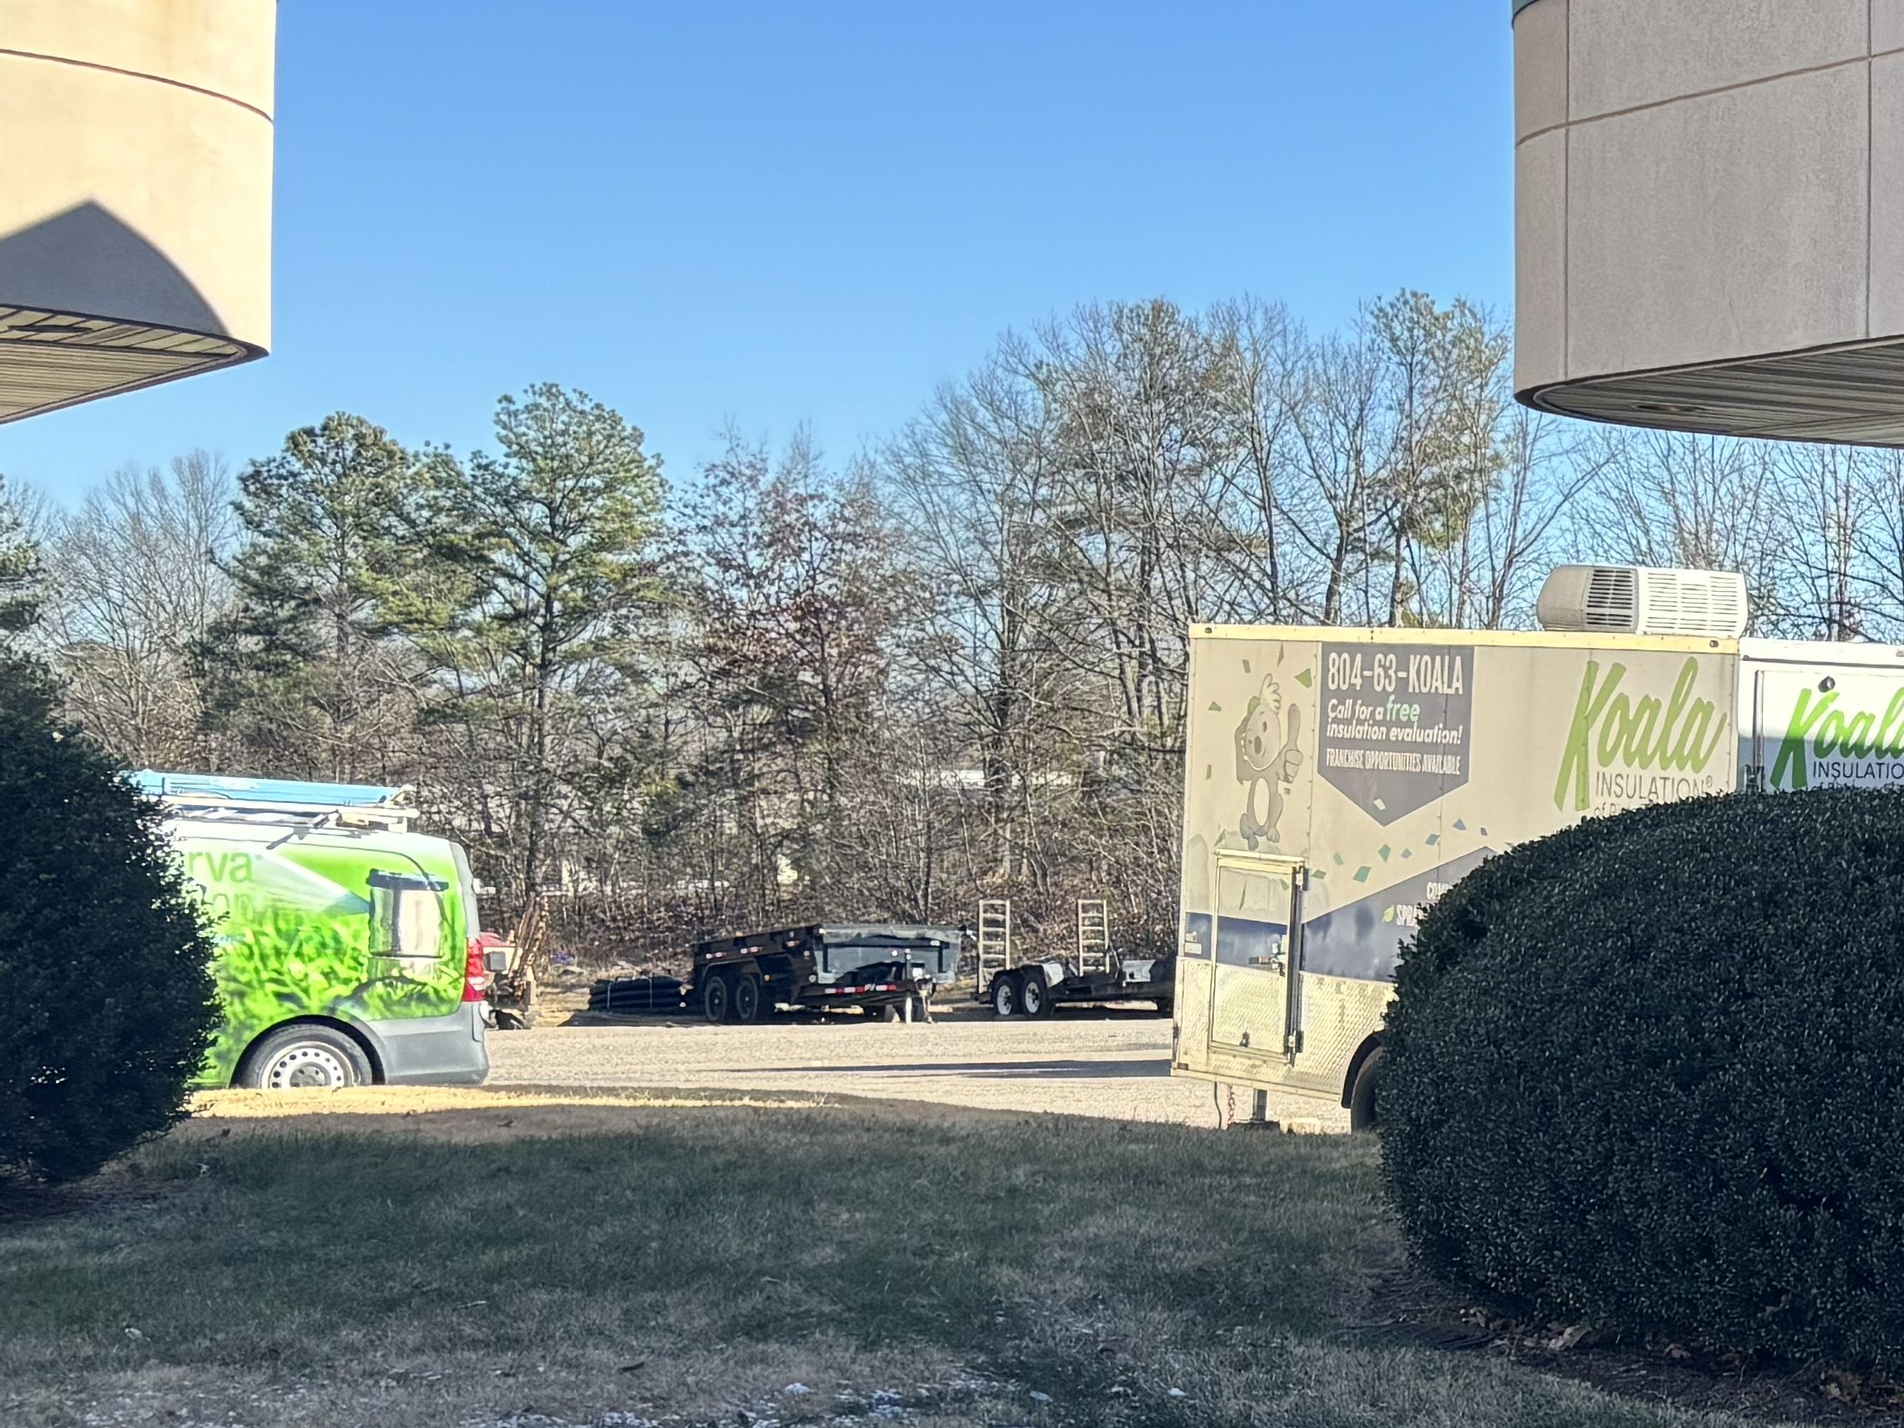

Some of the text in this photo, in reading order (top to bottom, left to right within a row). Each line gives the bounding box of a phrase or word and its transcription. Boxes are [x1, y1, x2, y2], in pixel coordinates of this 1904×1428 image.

[1327, 652, 1463, 694] 804-63-KOALA
[1328, 694, 1420, 722] Call for a free
[1326, 718, 1463, 744] insulation evaluation!
[1554, 656, 1727, 812] Koala
[1326, 748, 1461, 775] FRANCHISE OPPORTUNITIES AVAILABLE
